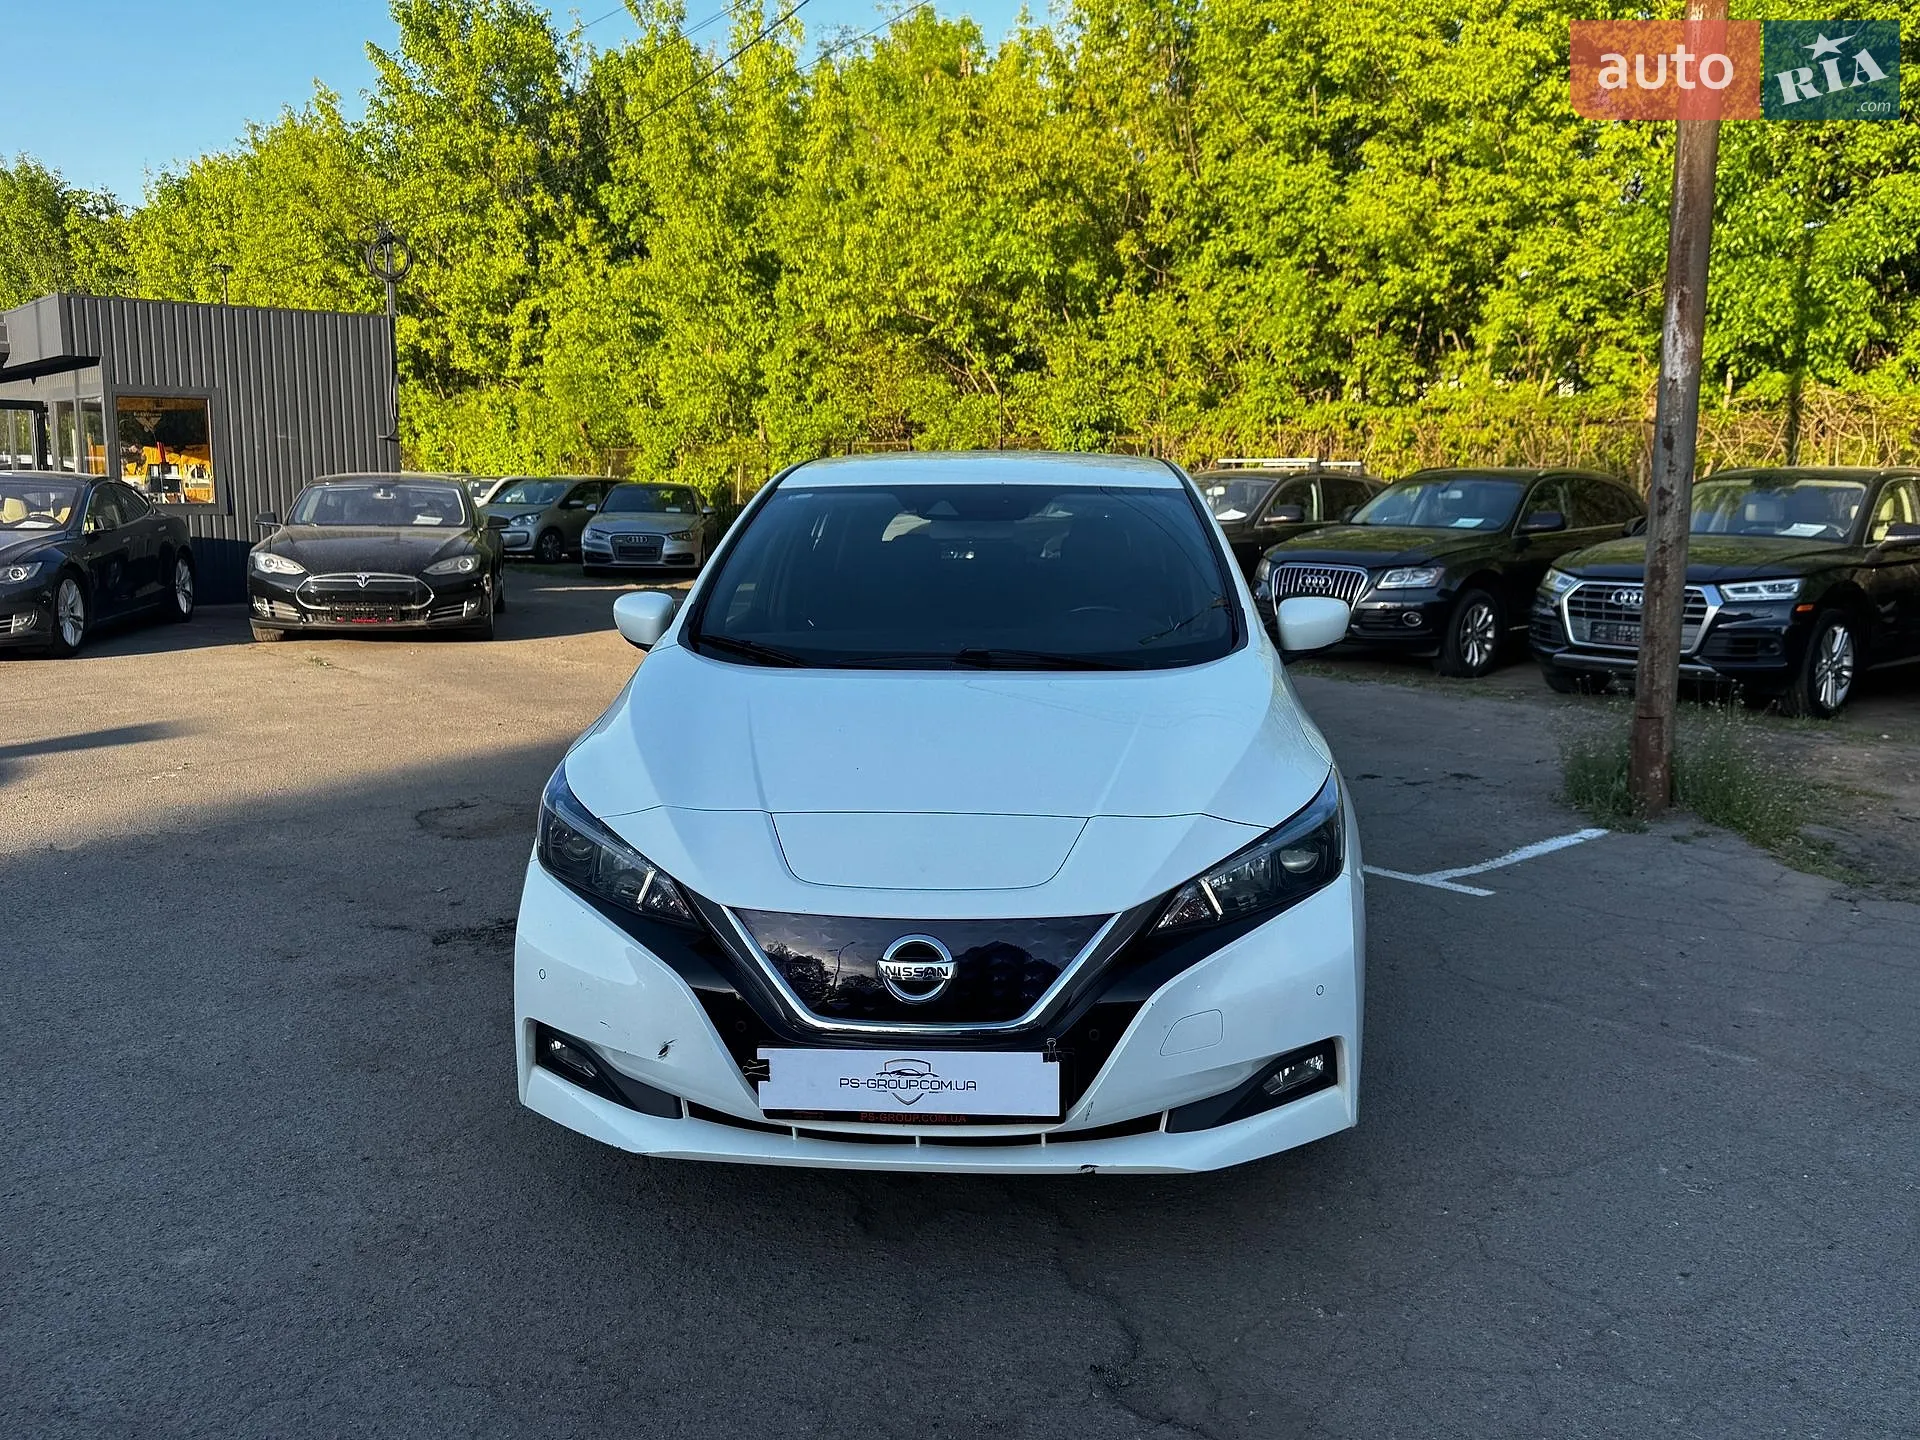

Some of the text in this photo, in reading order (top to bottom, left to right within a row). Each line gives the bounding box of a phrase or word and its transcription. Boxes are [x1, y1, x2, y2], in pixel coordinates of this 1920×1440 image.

[885, 965, 949, 977] NISSAN
[839, 1078, 977, 1091] PS-GROUP.COM.UA
[860, 1112, 967, 1123] PS-GROUP.COM.UA
